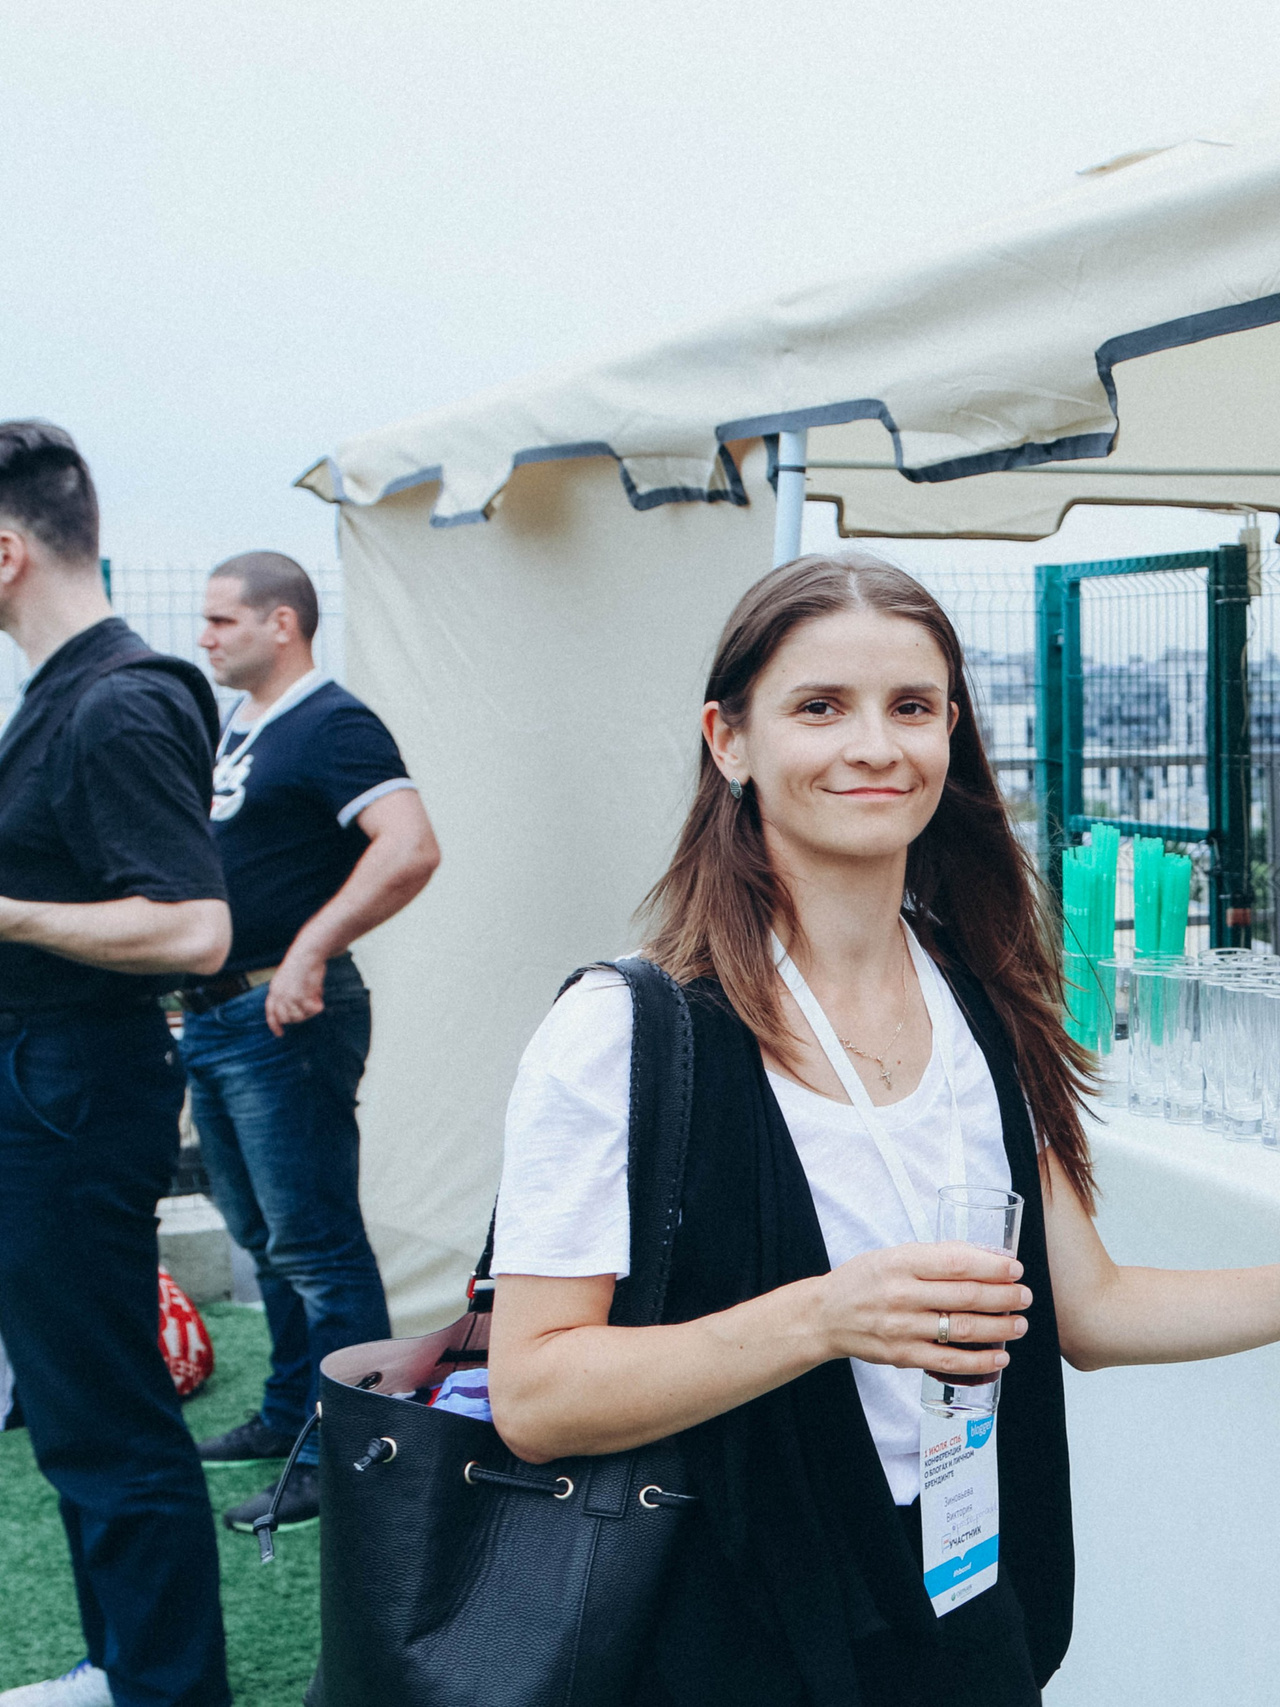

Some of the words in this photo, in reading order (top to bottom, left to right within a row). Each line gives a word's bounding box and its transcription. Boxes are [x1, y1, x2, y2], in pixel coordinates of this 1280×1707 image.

[924, 1444, 962, 1468] КОНФЕРЕНЦИЯ
[929, 1462, 949, 1477] БЛОГАХ
[953, 1449, 975, 1466] ЛИЧНОМ
[924, 1469, 954, 1490] БРЕНДИНГЕ
[946, 1504, 973, 1523] Виктория
[949, 1525, 982, 1549] УЧАСТНИК
